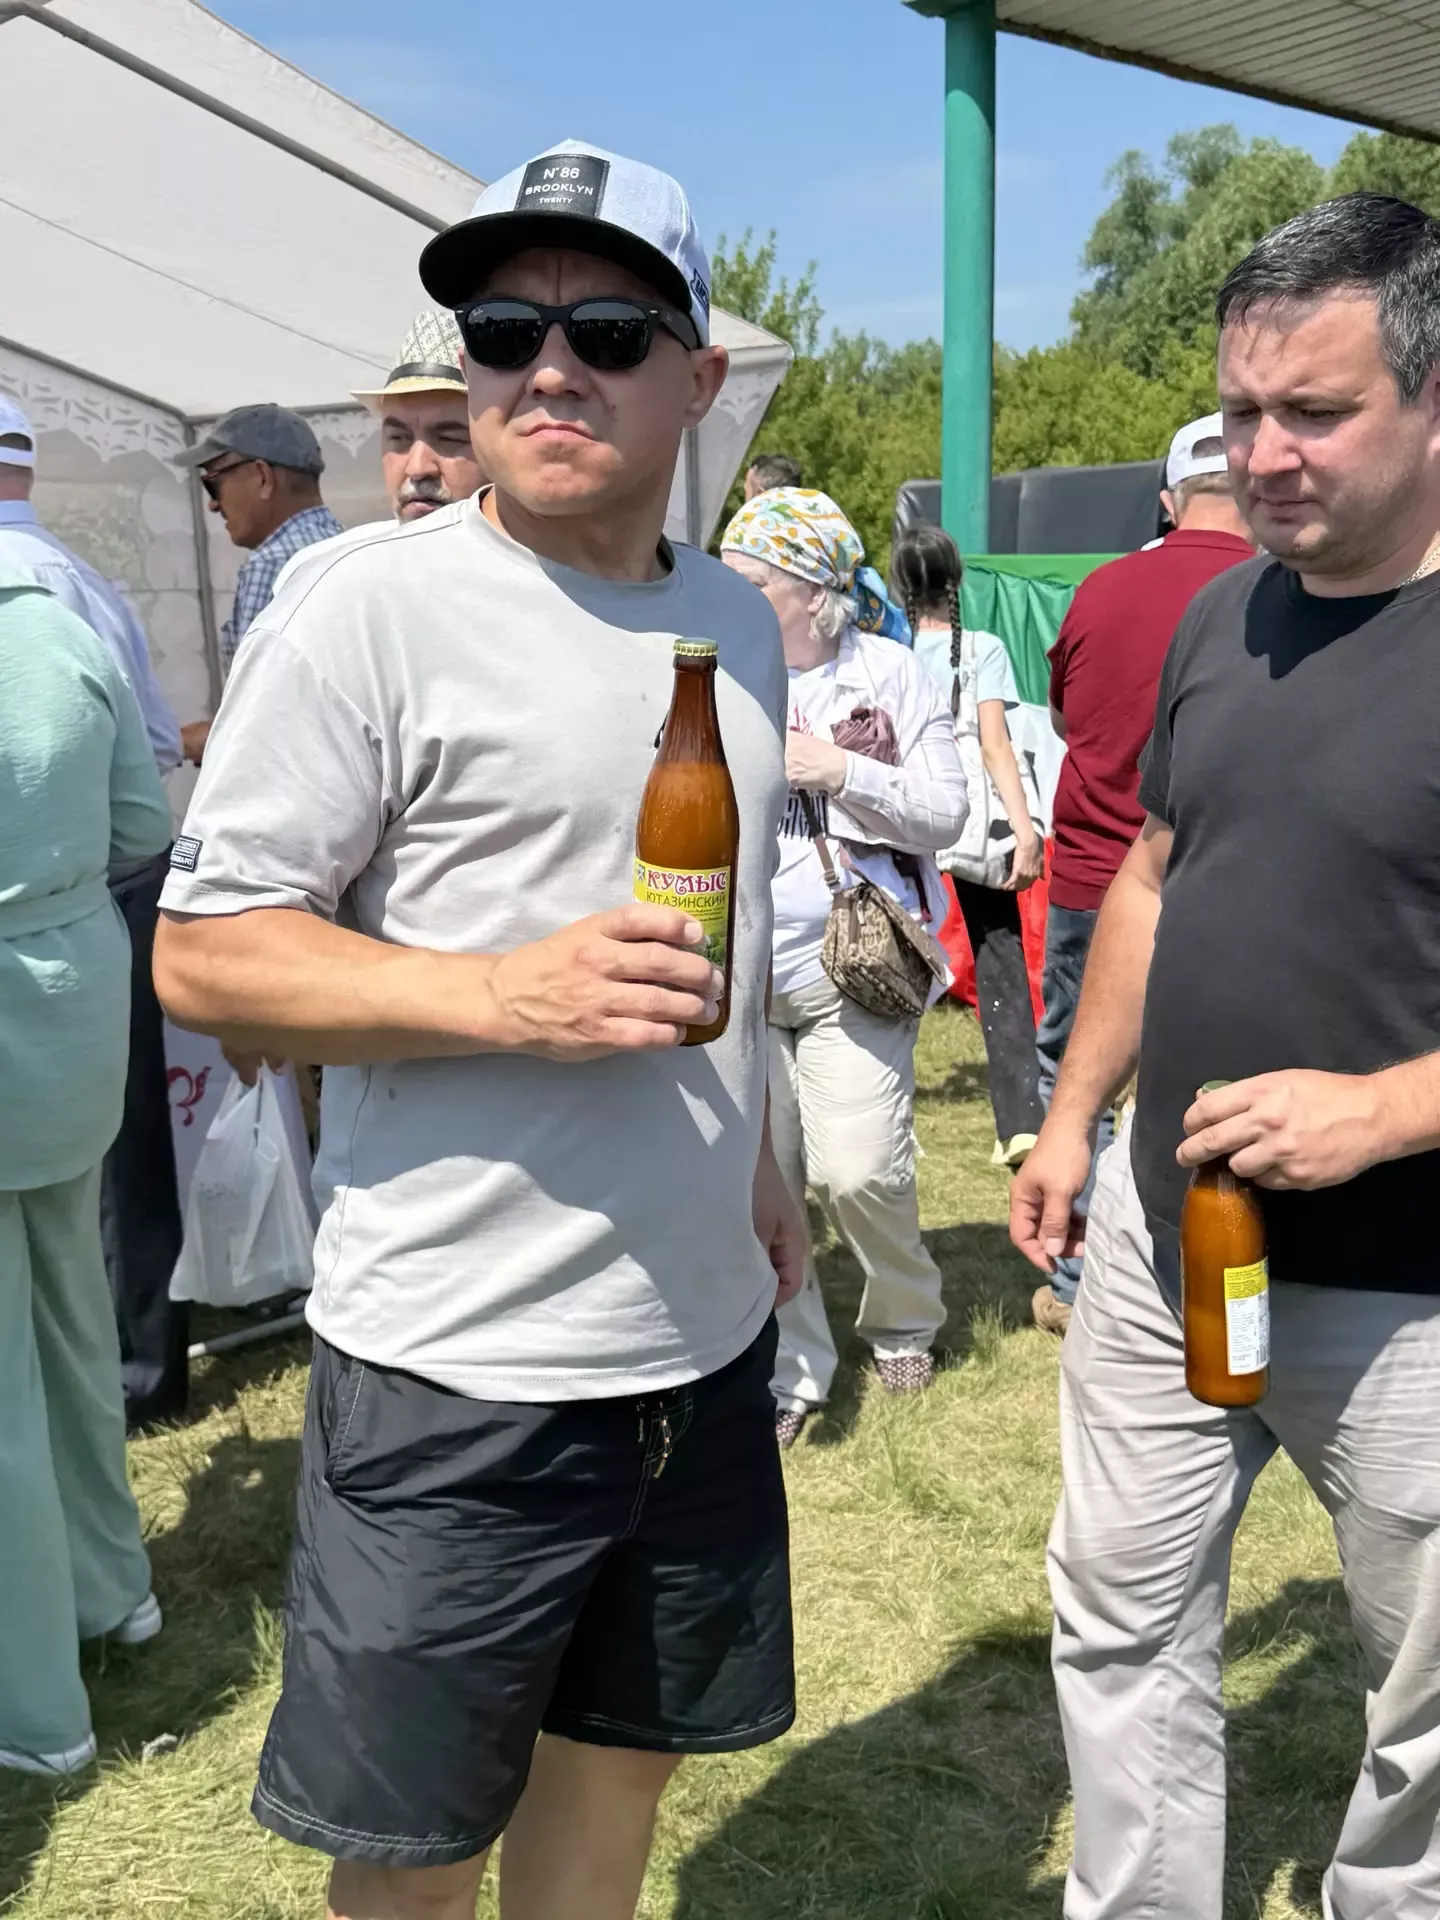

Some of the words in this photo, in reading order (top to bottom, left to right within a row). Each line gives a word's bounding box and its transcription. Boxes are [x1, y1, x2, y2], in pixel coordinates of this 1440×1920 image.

[525, 183, 594, 195] BROOKLYN
[647, 869, 727, 895] КУМЫС
[646, 892, 726, 908] ЮТАЗИНСКИЙ
